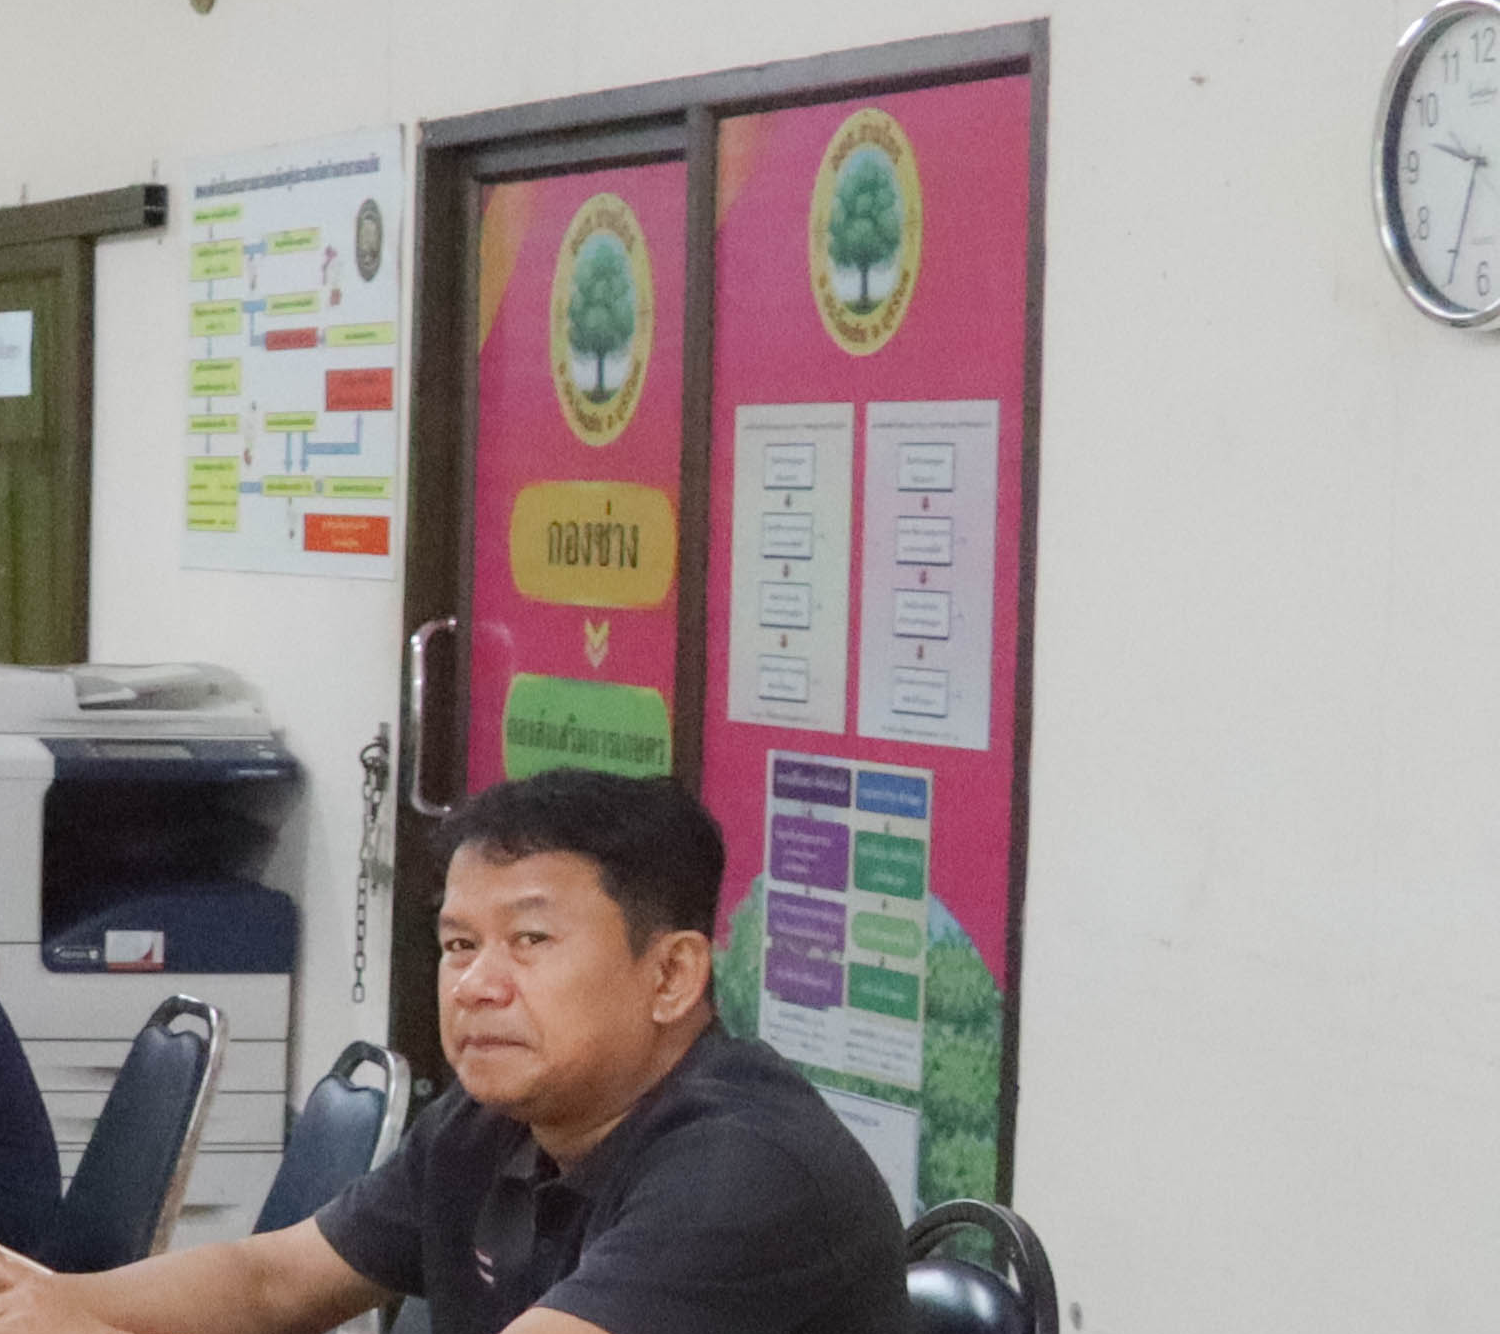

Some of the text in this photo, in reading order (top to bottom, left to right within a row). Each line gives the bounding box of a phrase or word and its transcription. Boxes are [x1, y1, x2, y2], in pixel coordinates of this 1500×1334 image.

[1470, 26, 1497, 64] 12
[1440, 50, 1461, 84] 11
[1416, 92, 1439, 128] 10
[1405, 149, 1420, 185] 9
[1417, 205, 1431, 241] 8
[1476, 260, 1491, 297] 6
[547, 498, 640, 569] กองช่าง
